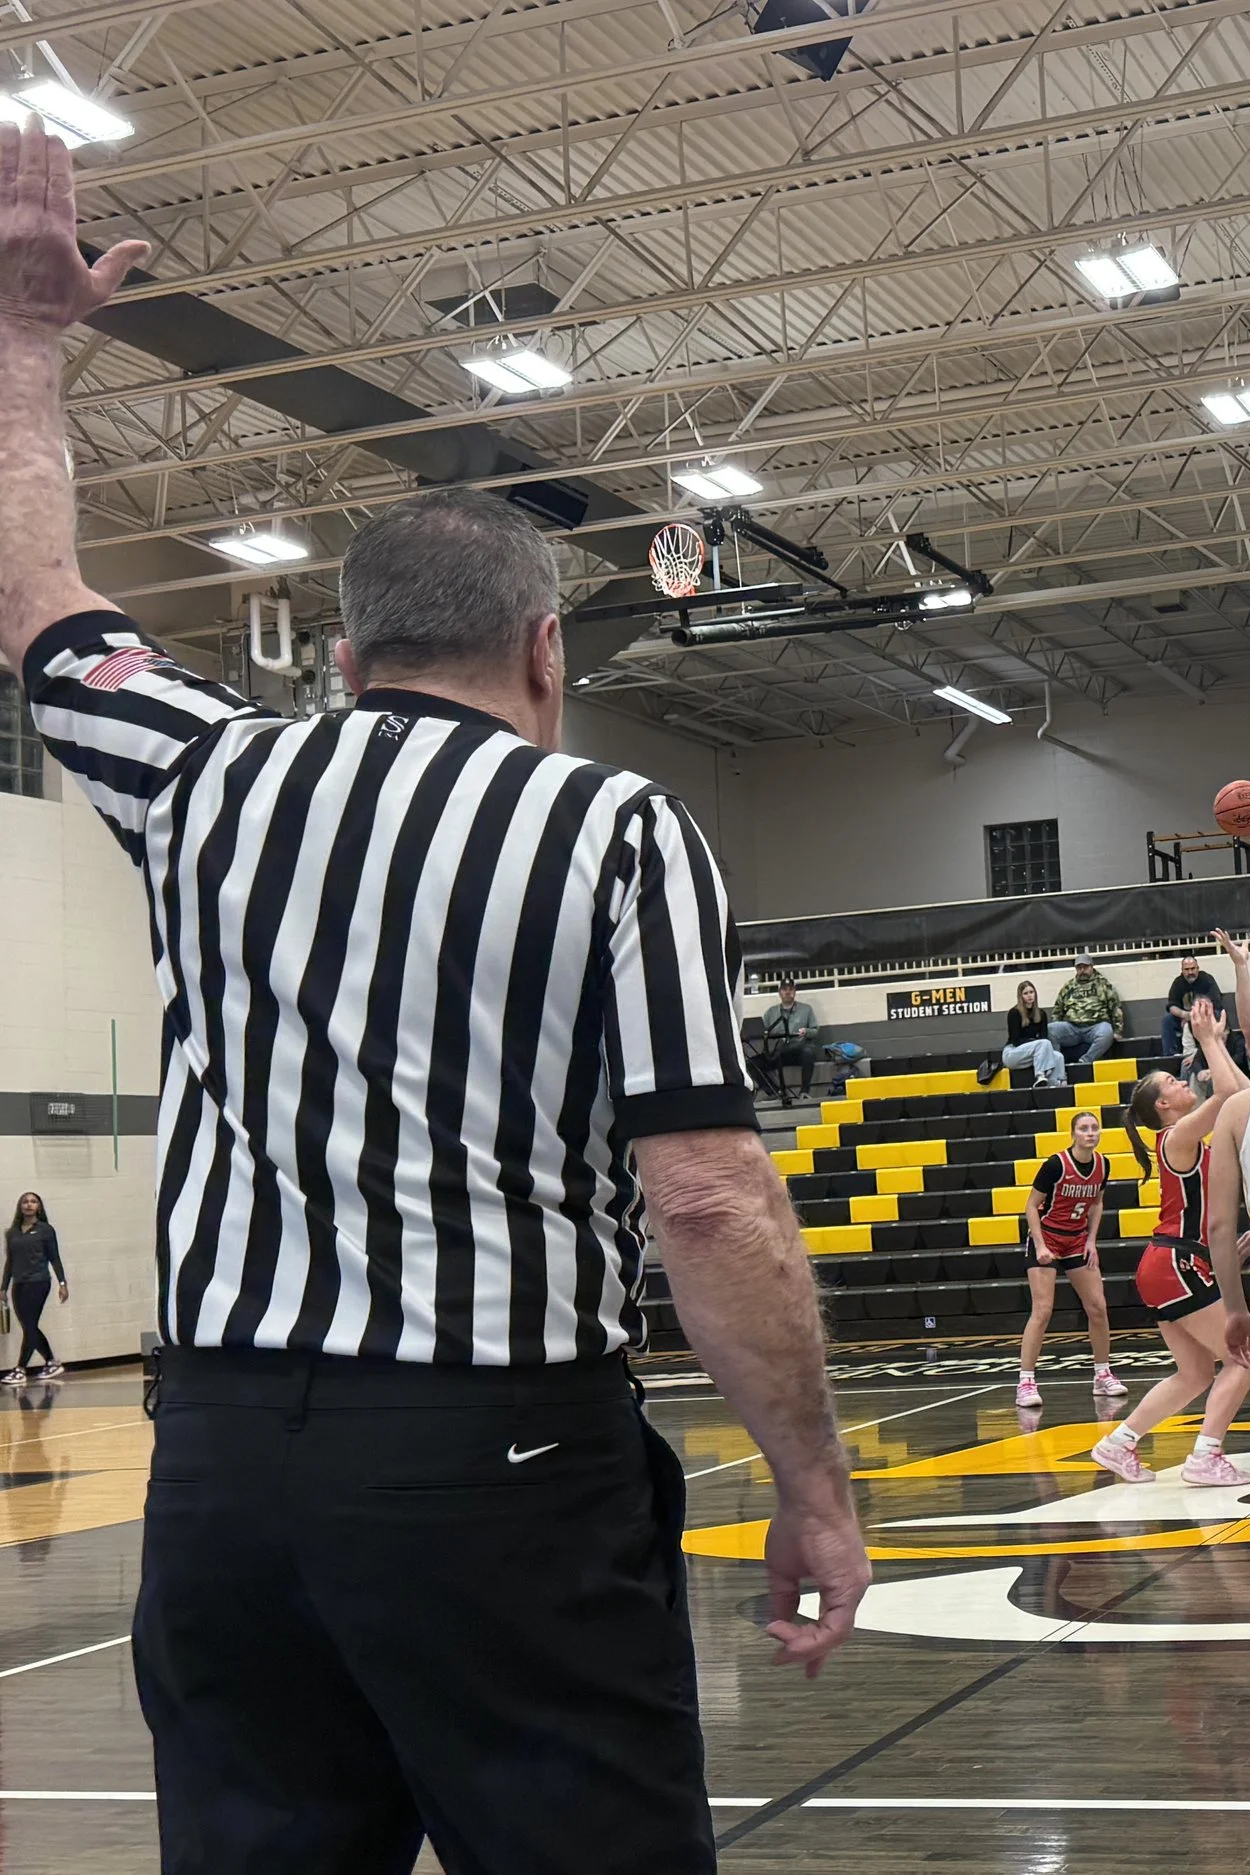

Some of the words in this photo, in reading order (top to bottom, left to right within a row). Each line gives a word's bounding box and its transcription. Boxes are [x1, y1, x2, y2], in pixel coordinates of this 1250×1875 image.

[911, 987, 966, 1006] G-MEN
[890, 1005, 940, 1020] STUDENT
[942, 1001, 988, 1015] SECTION
[1070, 1202, 1087, 1220] 5
